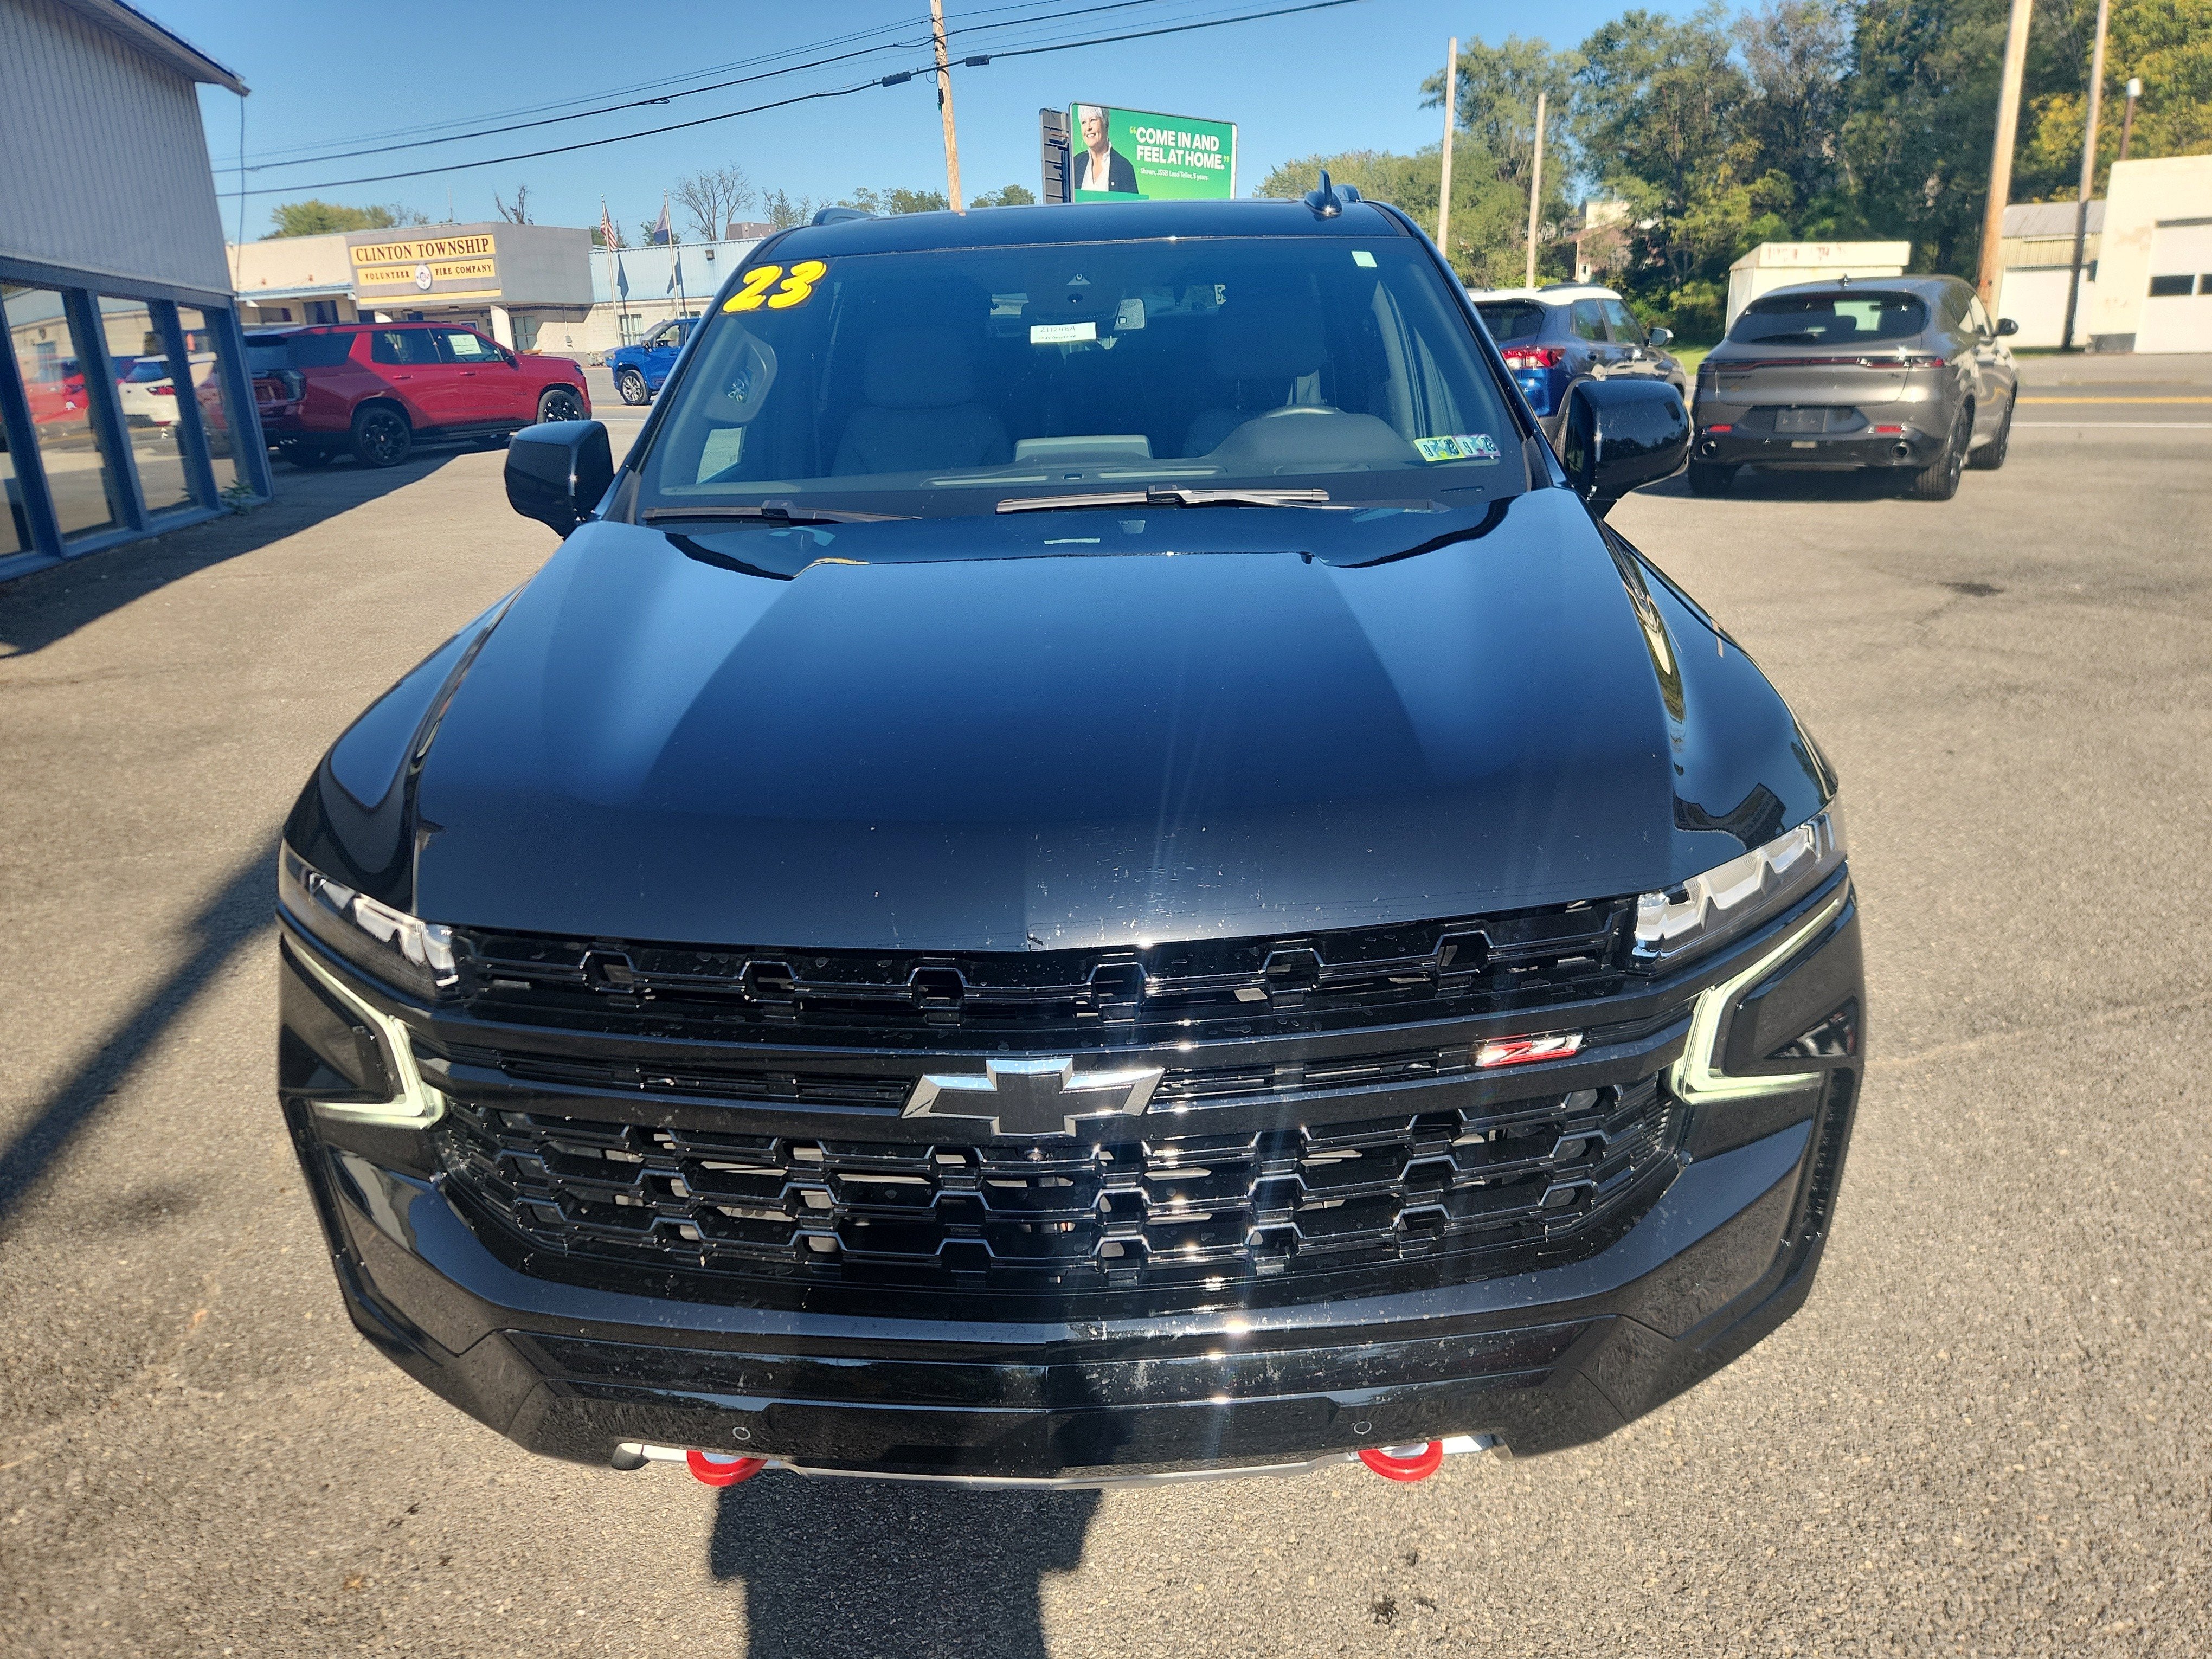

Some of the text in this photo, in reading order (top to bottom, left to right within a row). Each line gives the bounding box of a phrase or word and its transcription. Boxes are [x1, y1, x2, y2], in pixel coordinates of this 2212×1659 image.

[1178, 131, 1191, 149] IN
[1192, 133, 1219, 151] AND
[1136, 145, 1166, 164] FEEL
[1167, 149, 1184, 165] AT
[356, 238, 488, 261] CLINTON TOWNSHIP
[365, 264, 491, 280] VOLUNTEER FIRE COMPANY
[723, 261, 827, 312] 23
[1463, 442, 1473, 454] 9
